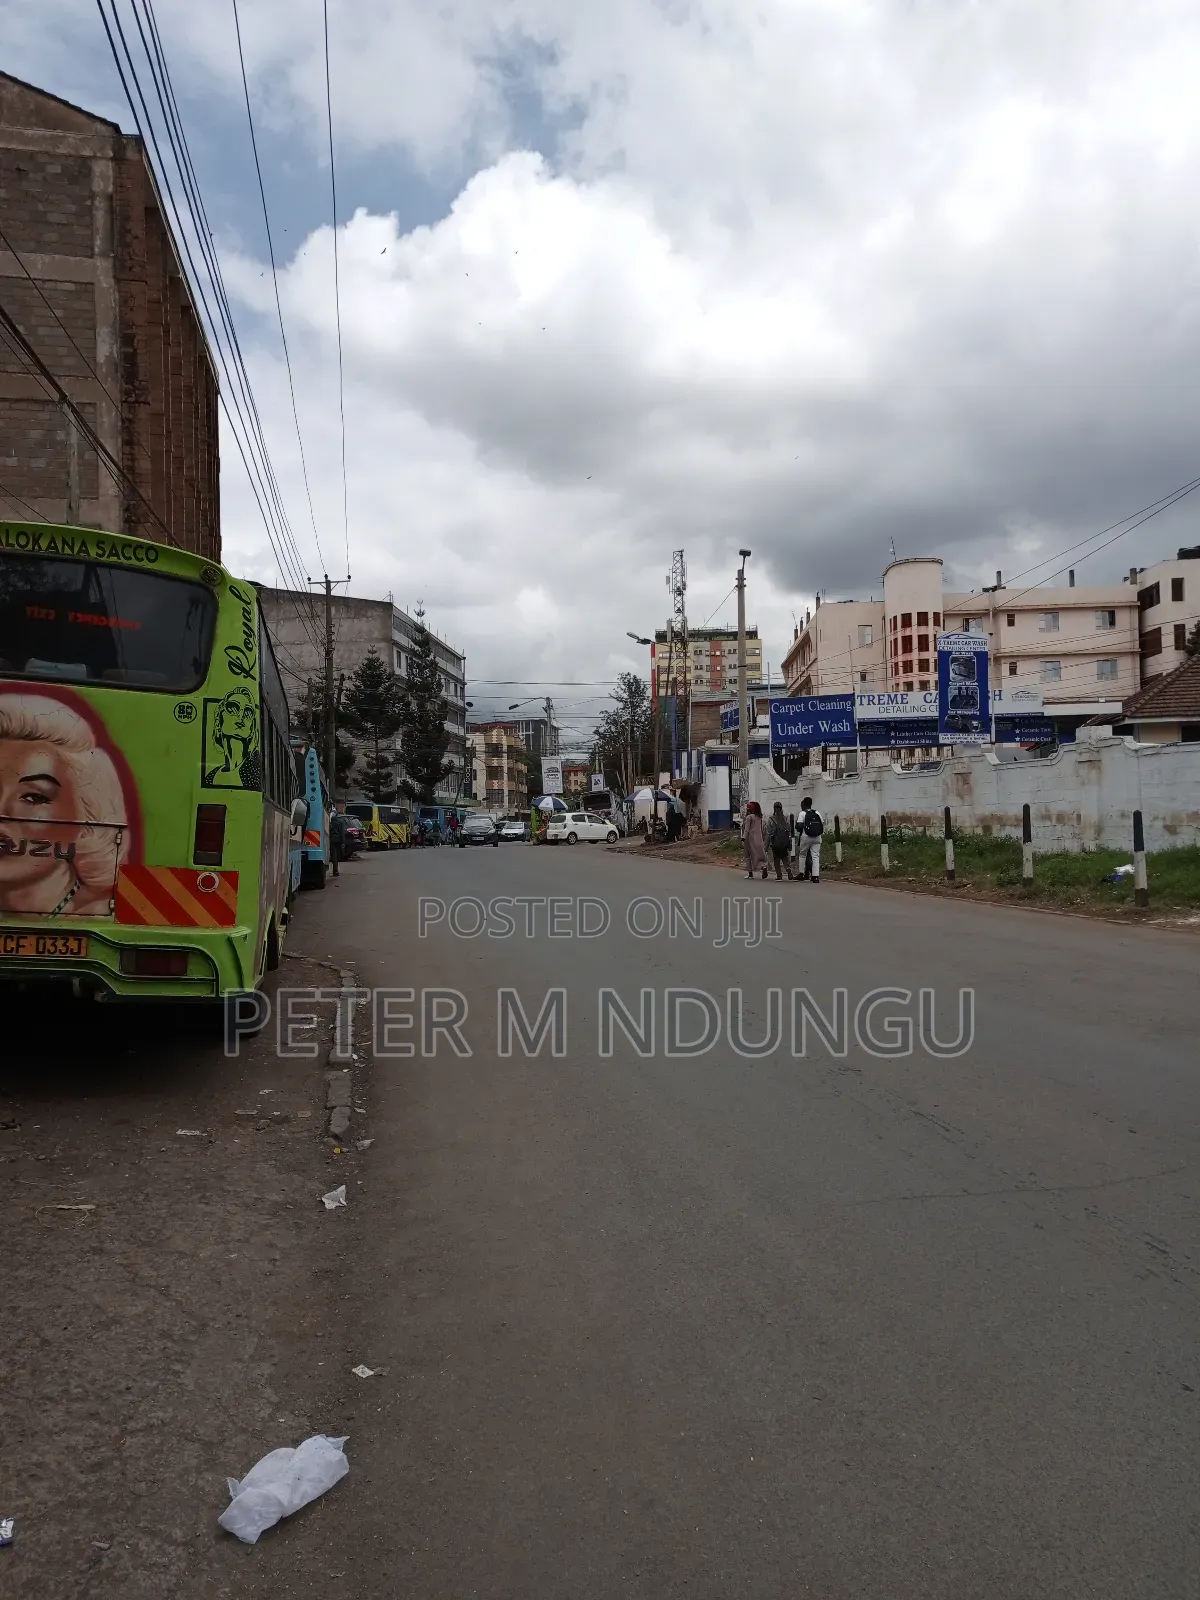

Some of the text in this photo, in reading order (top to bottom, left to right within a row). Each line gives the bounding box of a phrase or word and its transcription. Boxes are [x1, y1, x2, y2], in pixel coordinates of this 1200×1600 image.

[95, 540, 159, 563] SACCO
[224, 584, 257, 682] Royal
[771, 699, 852, 715] Carpet Cleaning
[878, 705, 927, 714] DETAILING
[777, 722, 814, 736] Under
[818, 719, 850, 732] Wash
[0, 934, 83, 956] CF 033J
